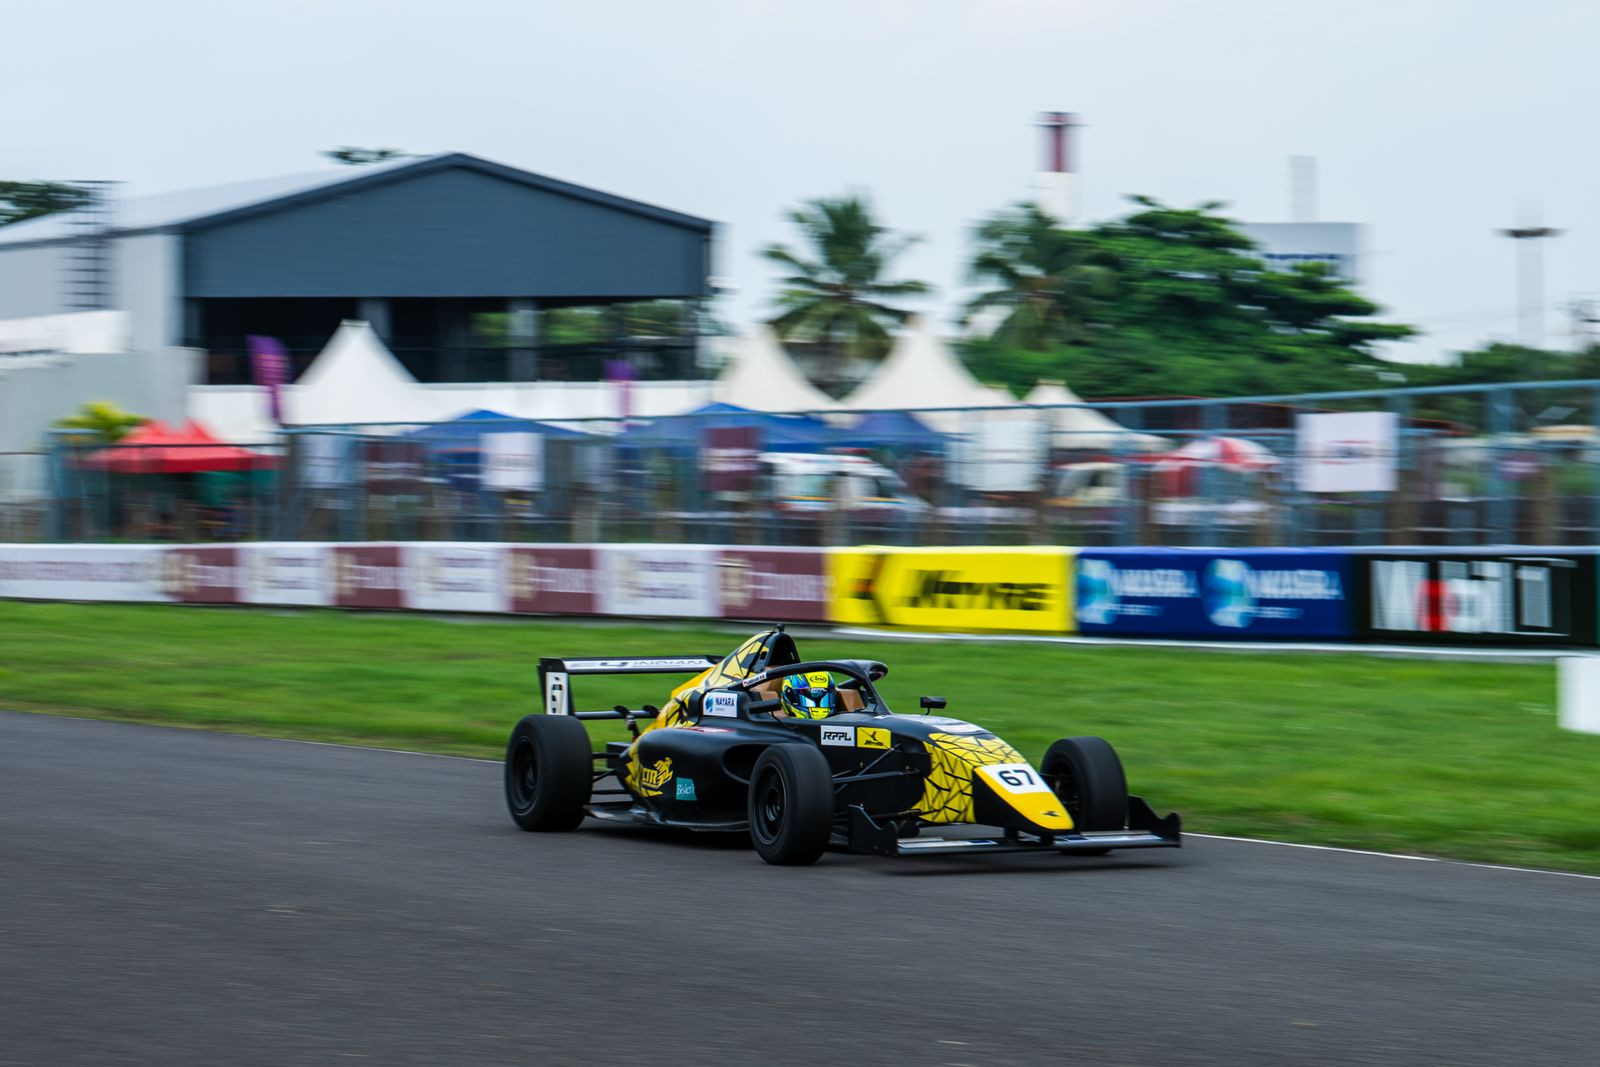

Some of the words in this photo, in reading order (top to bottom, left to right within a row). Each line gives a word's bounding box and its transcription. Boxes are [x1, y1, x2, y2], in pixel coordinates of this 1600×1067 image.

[715, 697, 735, 706] NAYARA
[822, 731, 852, 741] RPPL
[998, 769, 1035, 787] 67
